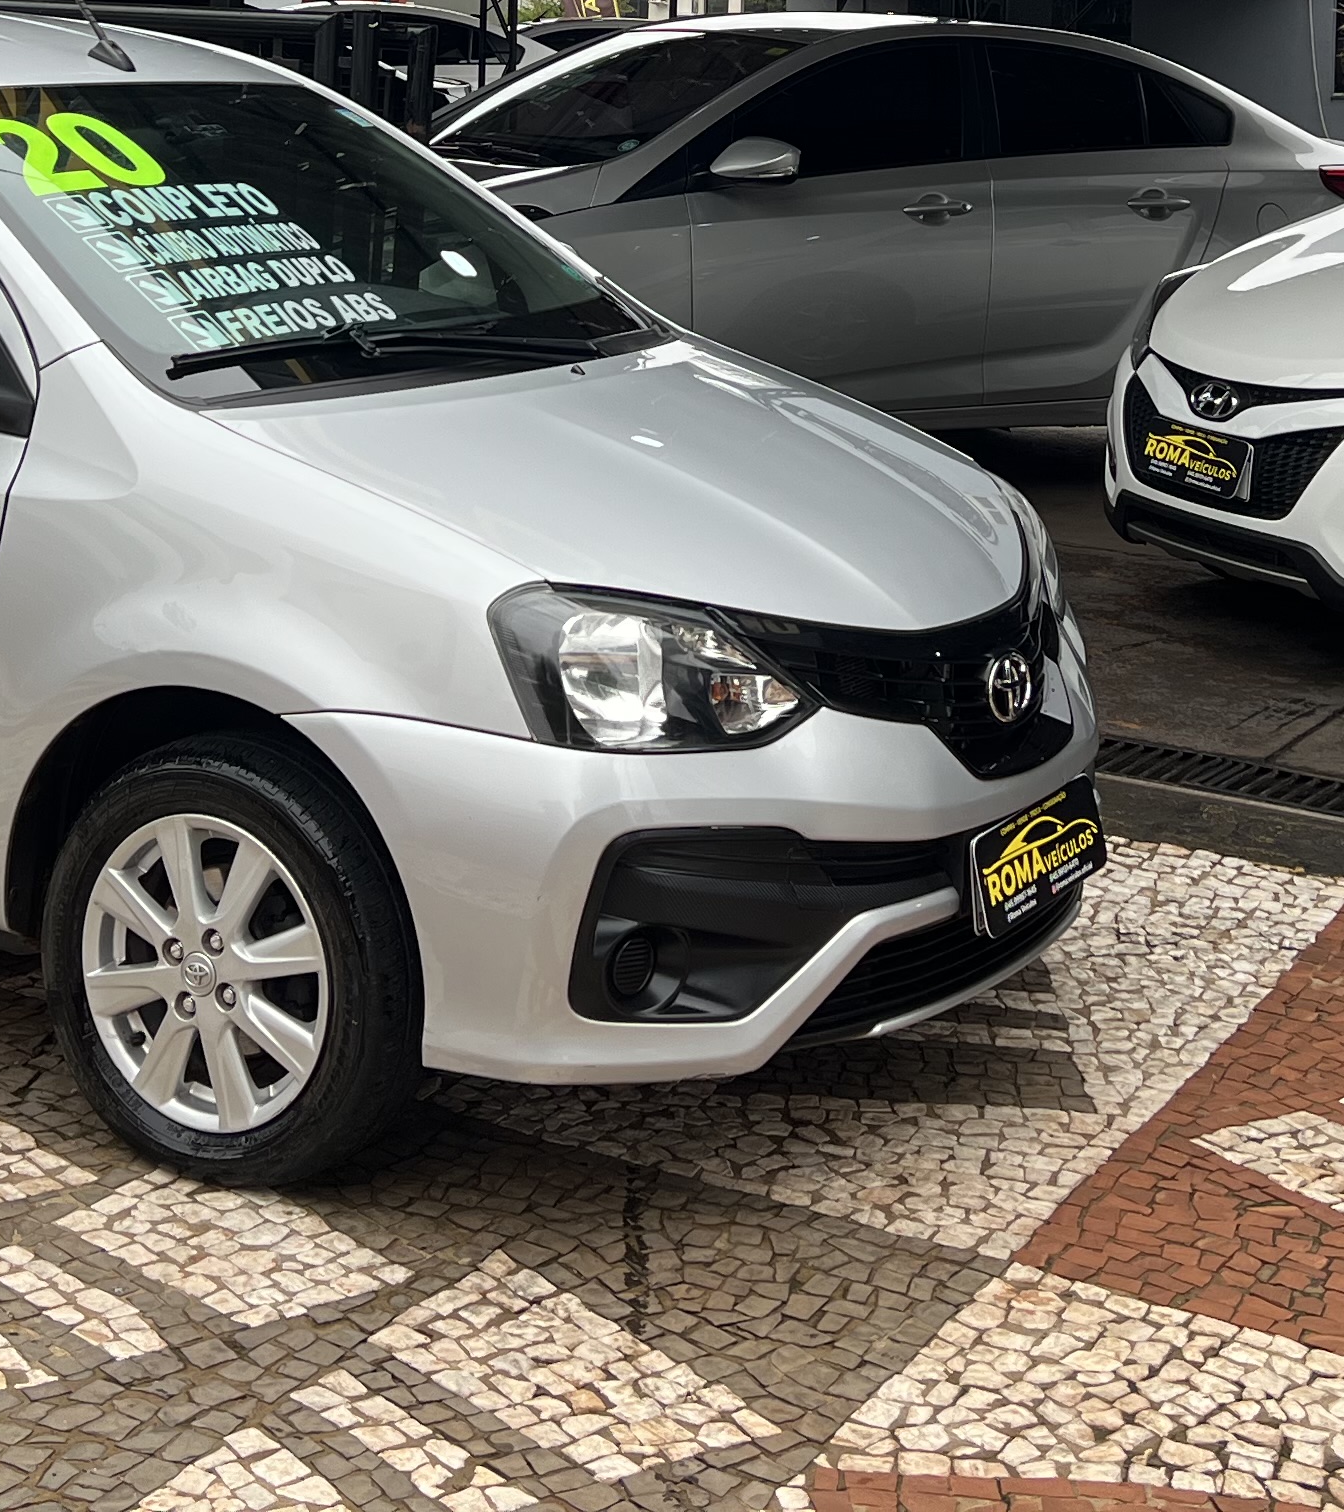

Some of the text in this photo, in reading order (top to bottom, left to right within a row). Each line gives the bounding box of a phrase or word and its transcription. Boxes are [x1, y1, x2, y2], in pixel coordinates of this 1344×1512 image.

[93, 182, 280, 227] COMPLETO
[137, 217, 321, 267] CÂMBIO AUTOMÁTICO
[180, 254, 356, 302] AIRBAG DUPLO
[216, 291, 398, 343] FREIOS ABS
[1144, 438, 1190, 468] ROMA
[1188, 457, 1232, 482] VEÍCULOS
[986, 847, 1047, 907] ROMA
[1045, 829, 1094, 872] VEÍCULOS
